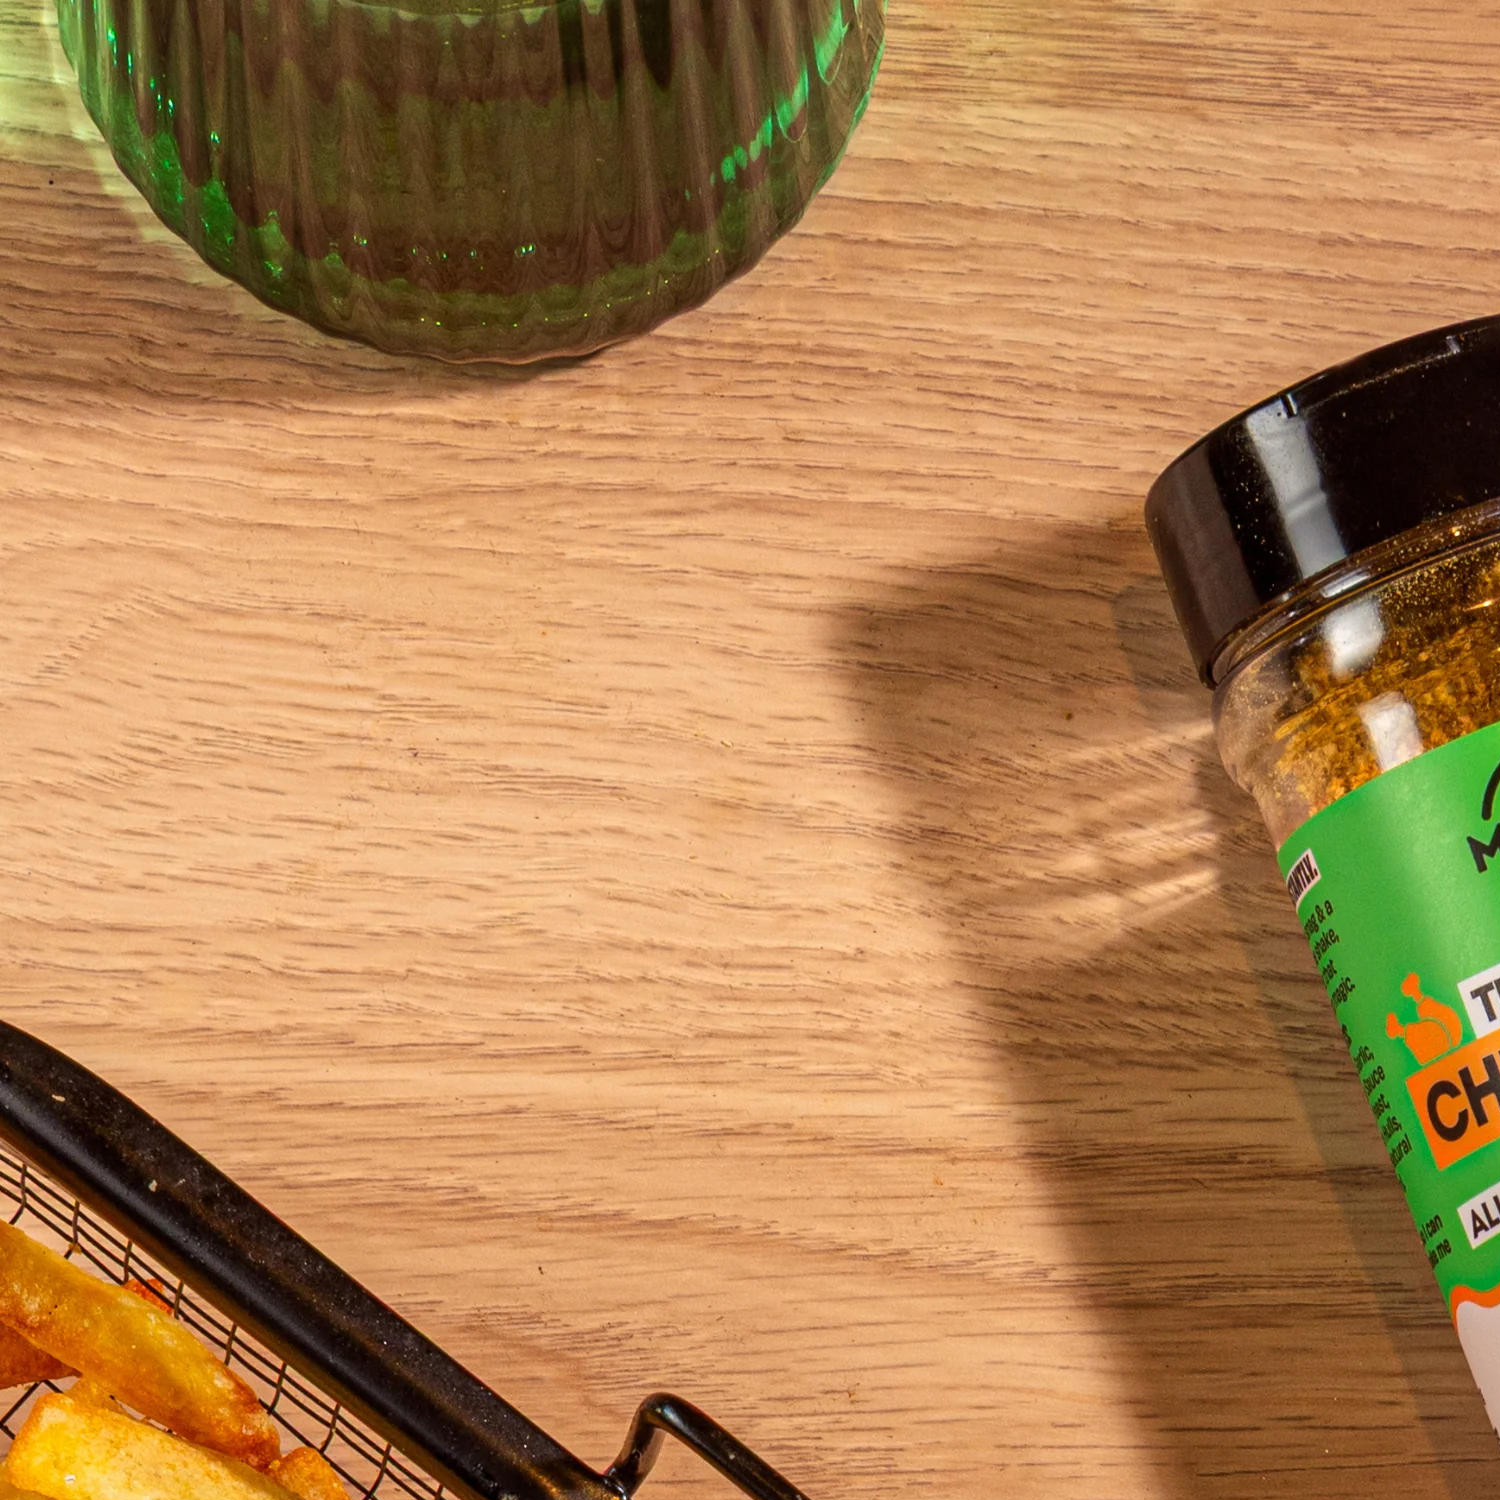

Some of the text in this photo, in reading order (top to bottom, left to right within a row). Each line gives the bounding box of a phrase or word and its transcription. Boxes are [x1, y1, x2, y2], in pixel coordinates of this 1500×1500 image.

[1315, 904, 1326, 923] &
[1324, 900, 1334, 916] a
[1425, 1214, 1444, 1238] can
[1435, 1238, 1453, 1260] me
